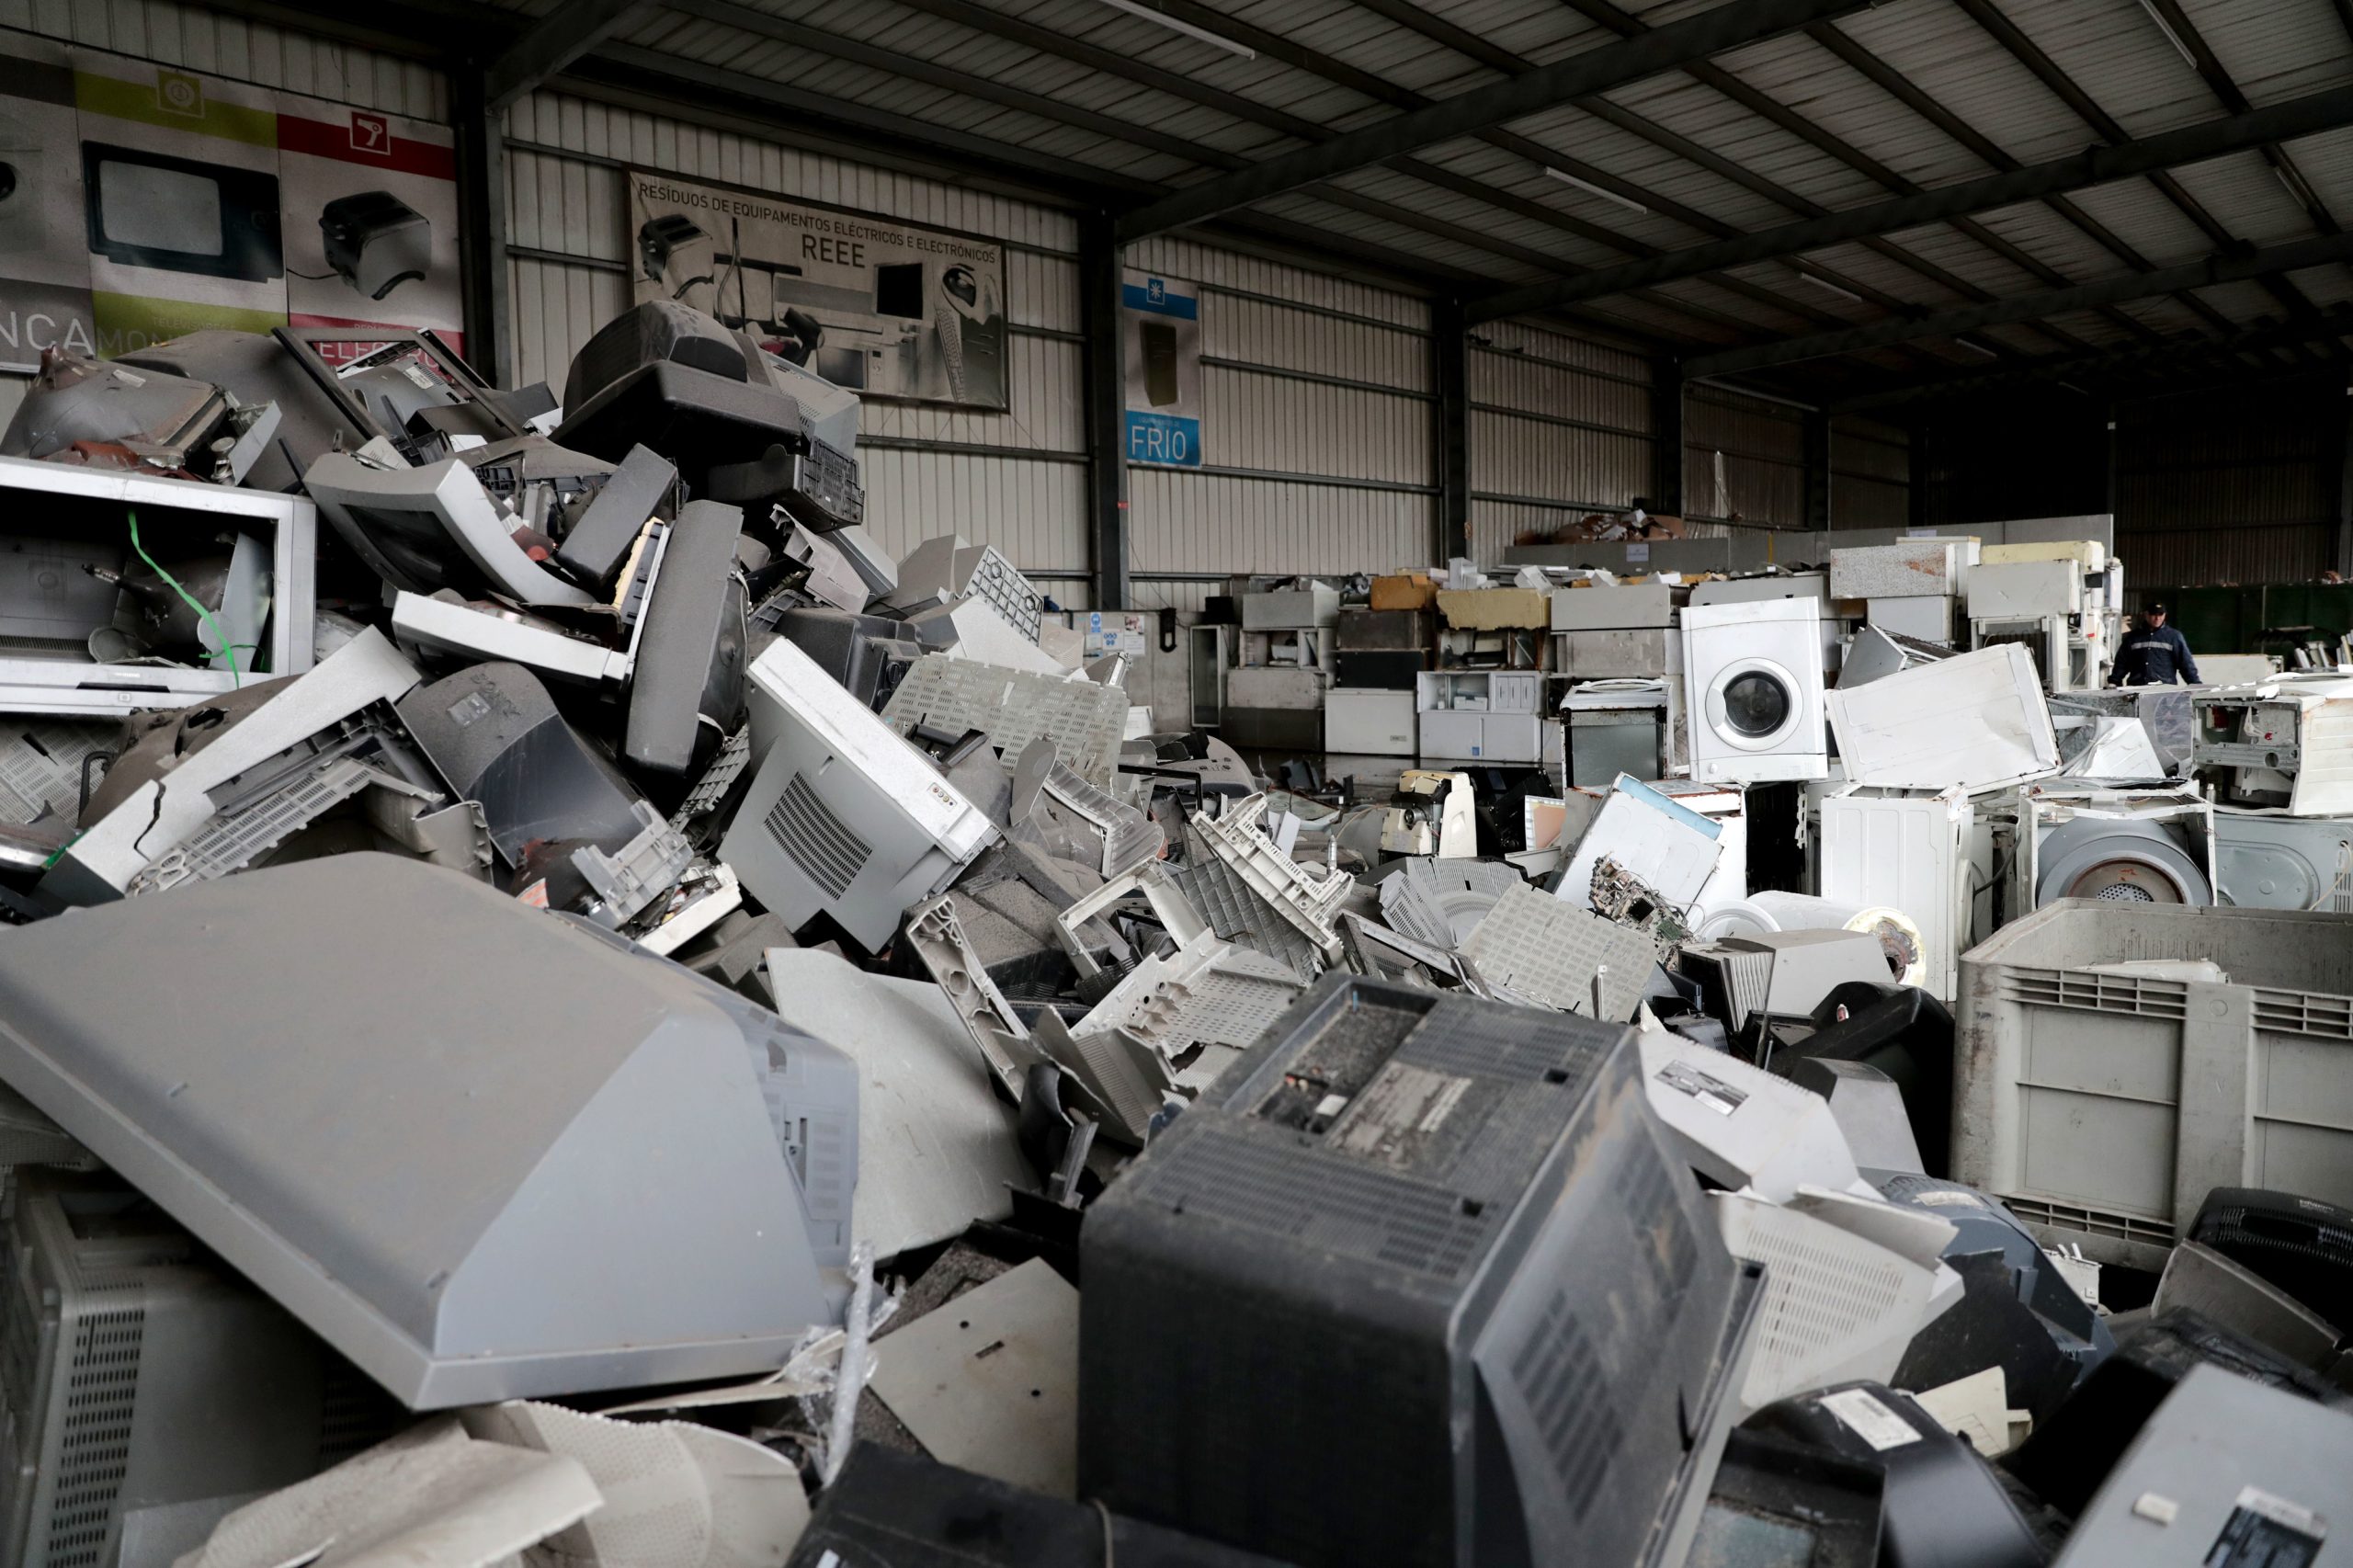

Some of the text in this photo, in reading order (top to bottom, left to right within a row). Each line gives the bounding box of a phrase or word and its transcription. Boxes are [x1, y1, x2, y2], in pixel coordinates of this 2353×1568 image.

[639, 183, 995, 264] RESÍDUOS DE EQUIPAMENTOS ELÉCTRICOS E ELECTRÓNICOS
[801, 233, 866, 268] REEE
[1131, 425, 1187, 460] FRIO
